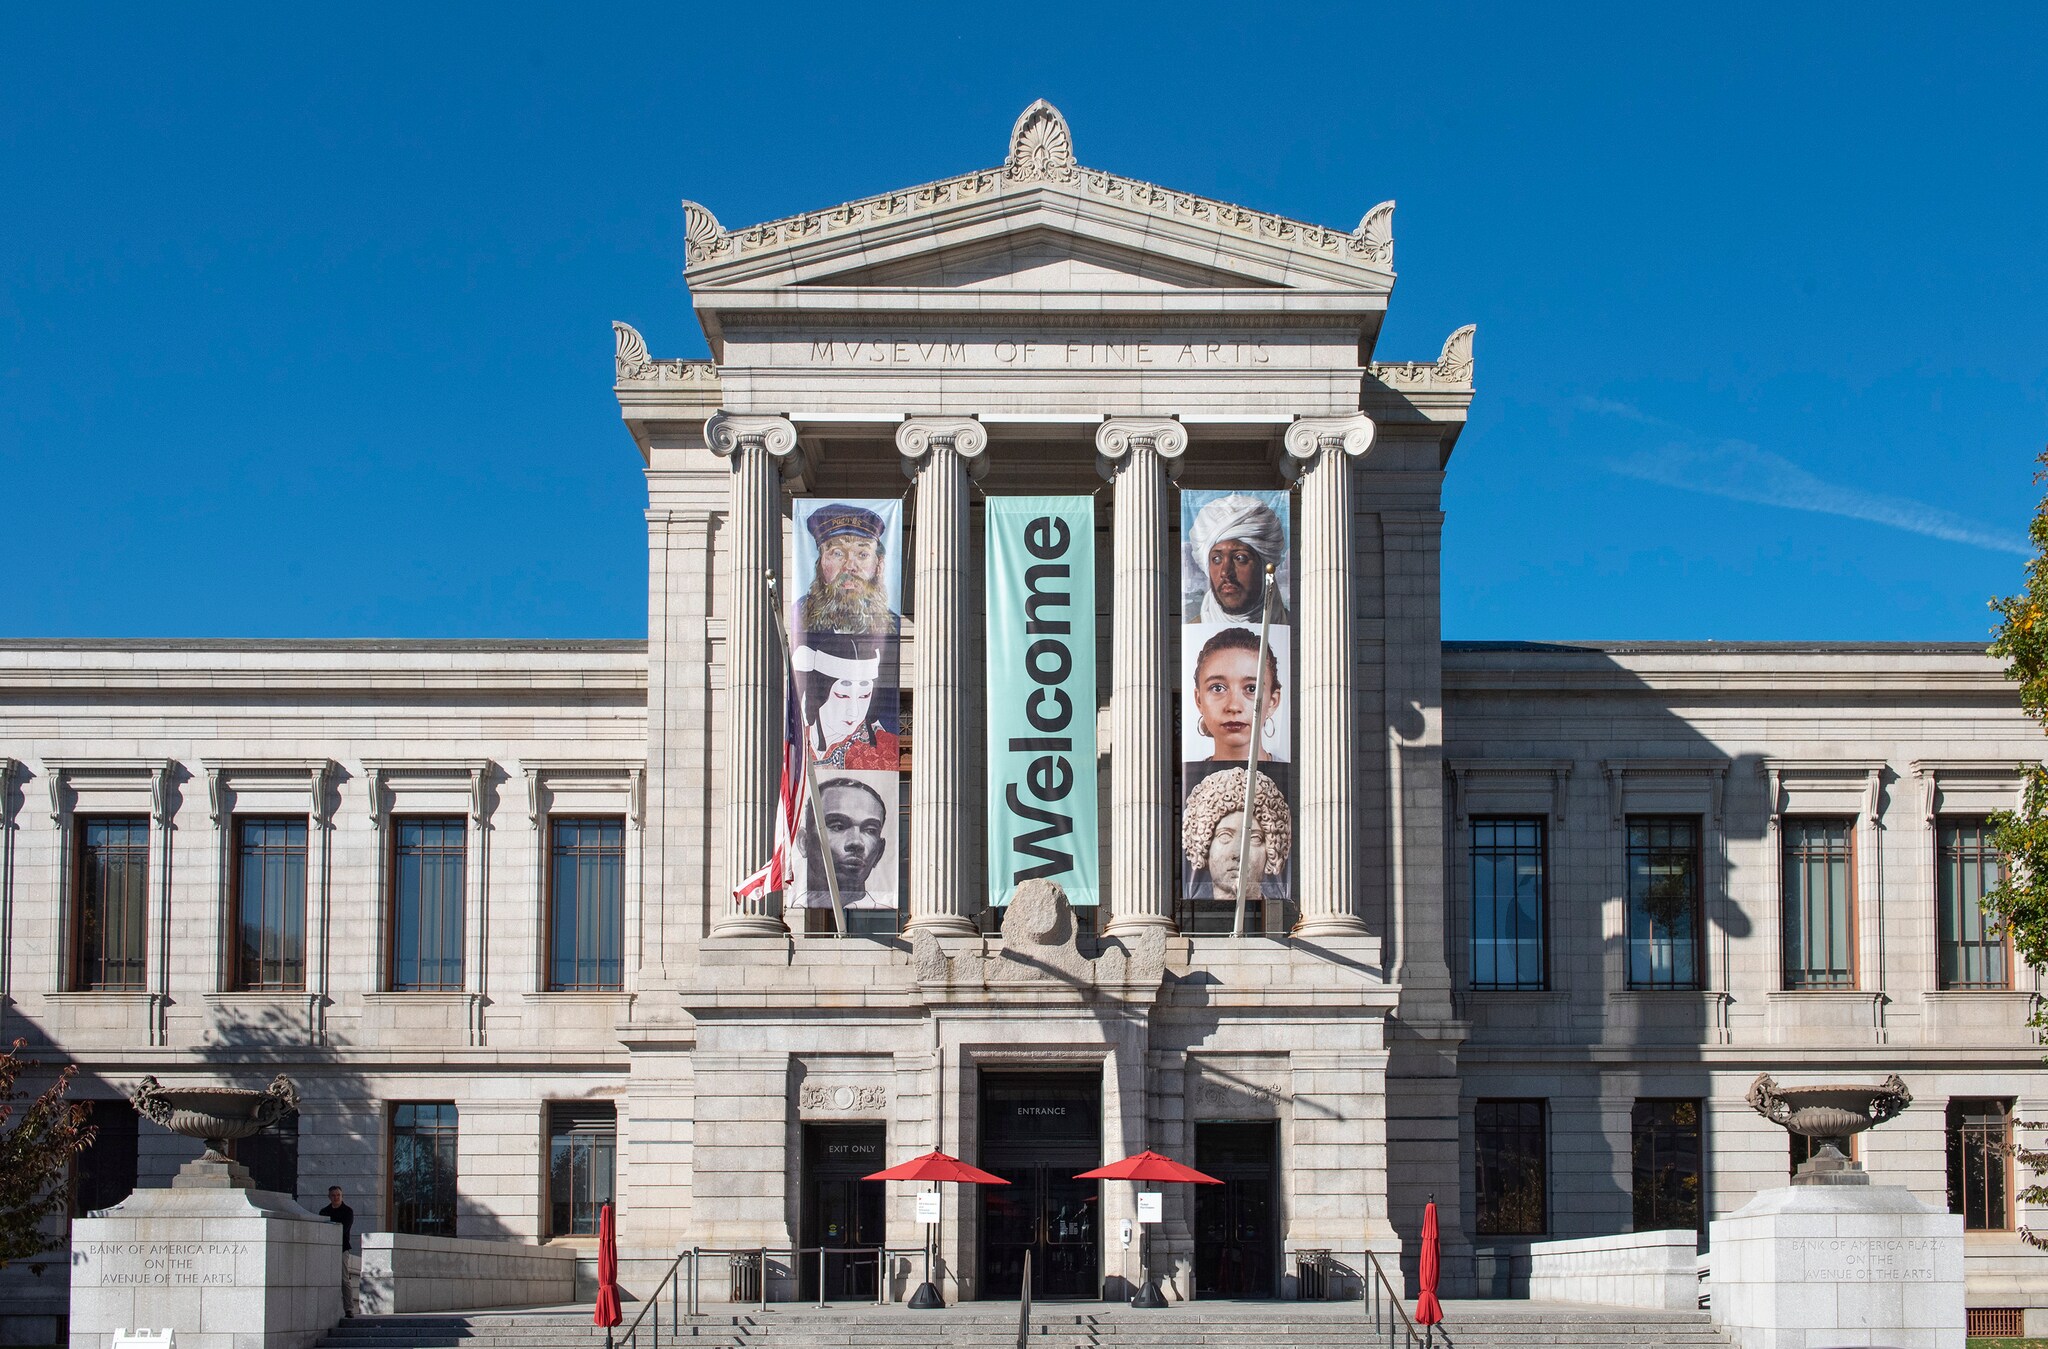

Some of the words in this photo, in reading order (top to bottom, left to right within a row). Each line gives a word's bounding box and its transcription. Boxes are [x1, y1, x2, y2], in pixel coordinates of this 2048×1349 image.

[811, 341, 966, 363] MVSEVM
[993, 340, 1038, 363] OF
[1066, 340, 1154, 363] FINE
[1176, 340, 1270, 363] ARTS
[1006, 516, 1074, 887] Welcome
[1017, 1107, 1066, 1115] ENTRANCE
[829, 1145, 849, 1153] EXIT
[851, 1145, 876, 1153] ONLY
[90, 1245, 123, 1254] BANK
[128, 1245, 145, 1254] OF
[150, 1245, 204, 1254] AMERICA
[209, 1245, 248, 1254] PLAZA
[1792, 1240, 1825, 1250] BANK
[1829, 1240, 1846, 1250] OF
[1851, 1240, 1904, 1250] AMERICA
[1908, 1240, 1946, 1250] PLAZA
[145, 1259, 164, 1269] ON
[169, 1259, 193, 1268] THE
[1846, 1255, 1866, 1265] ON
[1870, 1254, 1893, 1265] THE
[102, 1274, 150, 1283] AVENUE
[154, 1274, 170, 1284] OF
[175, 1274, 199, 1283] THE
[203, 1274, 233, 1283] ARTS
[1805, 1269, 1852, 1279] AVENUE
[1856, 1269, 1873, 1280] OF
[1876, 1269, 1899, 1279] THE
[1903, 1269, 1932, 1279] ARTS
